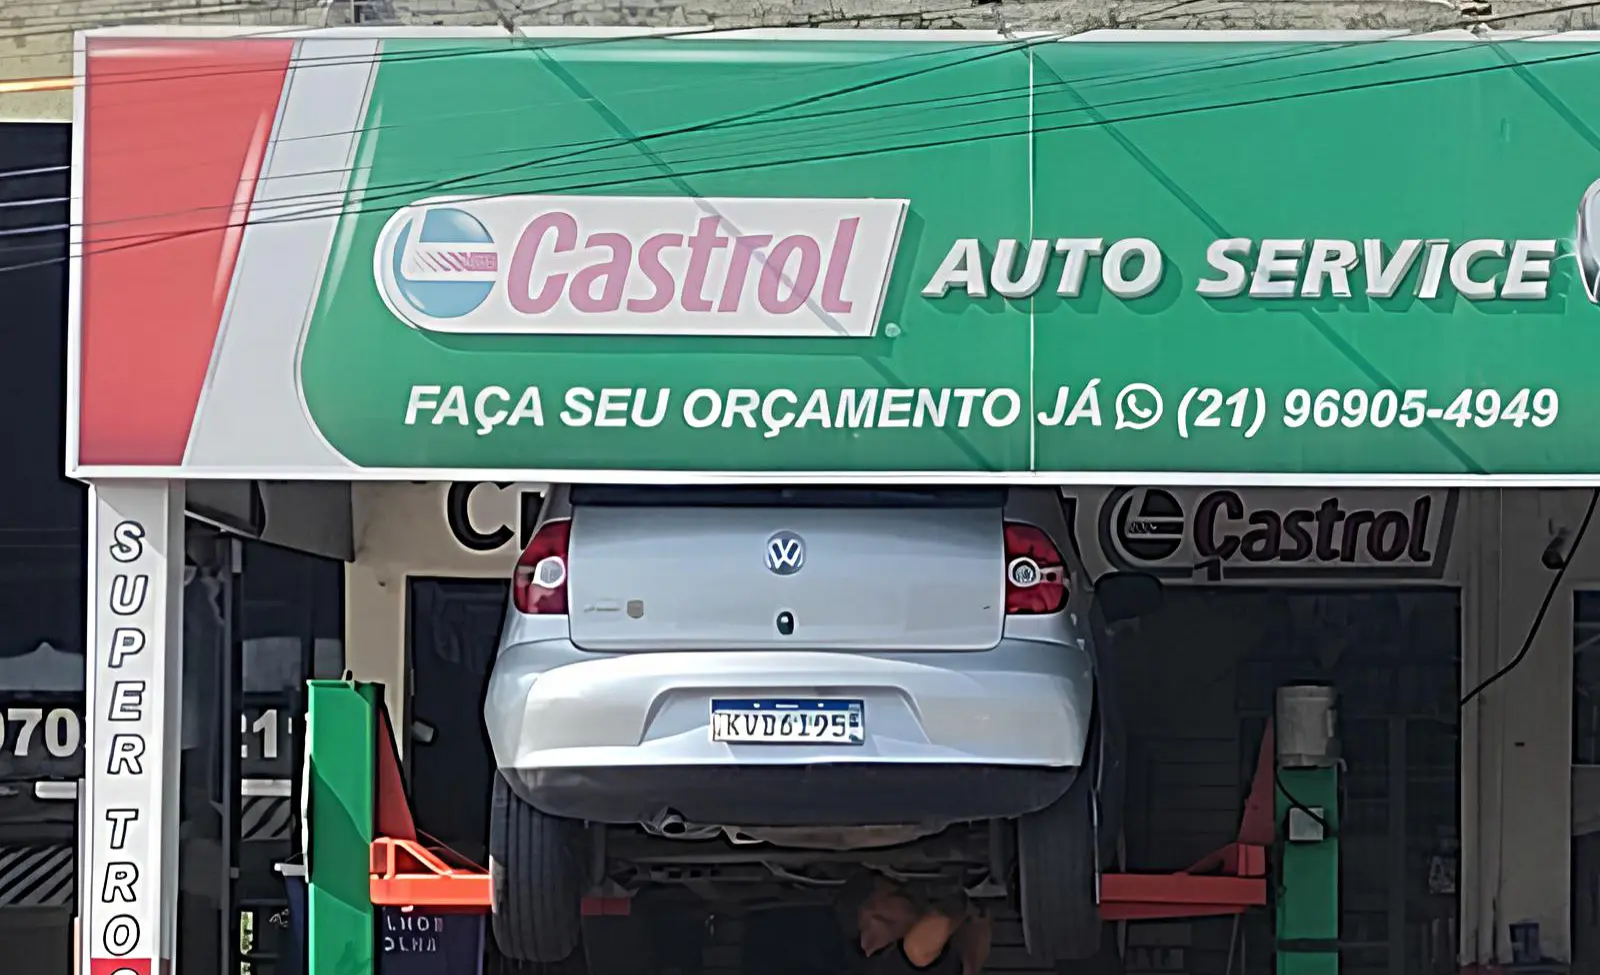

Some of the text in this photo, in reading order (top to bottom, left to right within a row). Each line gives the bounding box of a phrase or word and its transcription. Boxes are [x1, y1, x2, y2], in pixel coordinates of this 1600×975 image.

[506, 212, 861, 314] Castrol
[922, 238, 1557, 300] AUTO SERVICE
[405, 379, 1558, 439] FAÇA SEU ORÇAMENTO JÁ (21) 96905-4949
[1194, 488, 1433, 564] Castrol
[107, 521, 148, 775] SUPER
